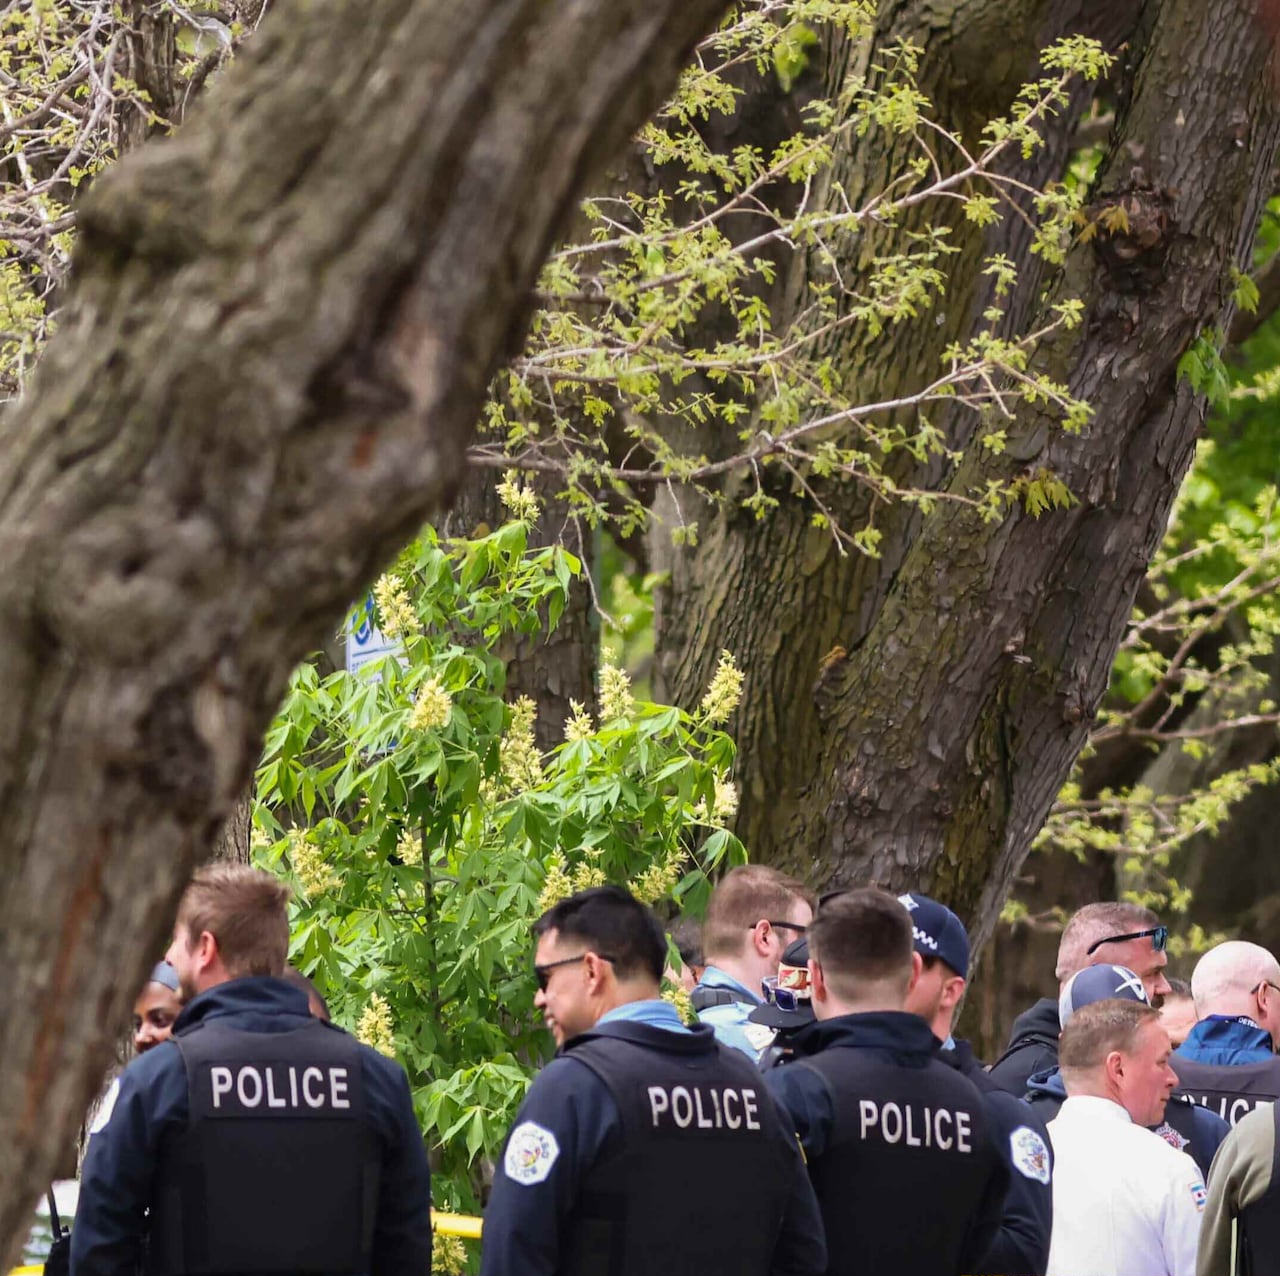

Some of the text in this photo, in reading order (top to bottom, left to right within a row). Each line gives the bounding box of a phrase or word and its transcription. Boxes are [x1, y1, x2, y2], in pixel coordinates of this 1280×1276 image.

[211, 1066, 350, 1108] POLICE
[648, 1085, 761, 1130] POLICE
[859, 1100, 972, 1153] POLICE
